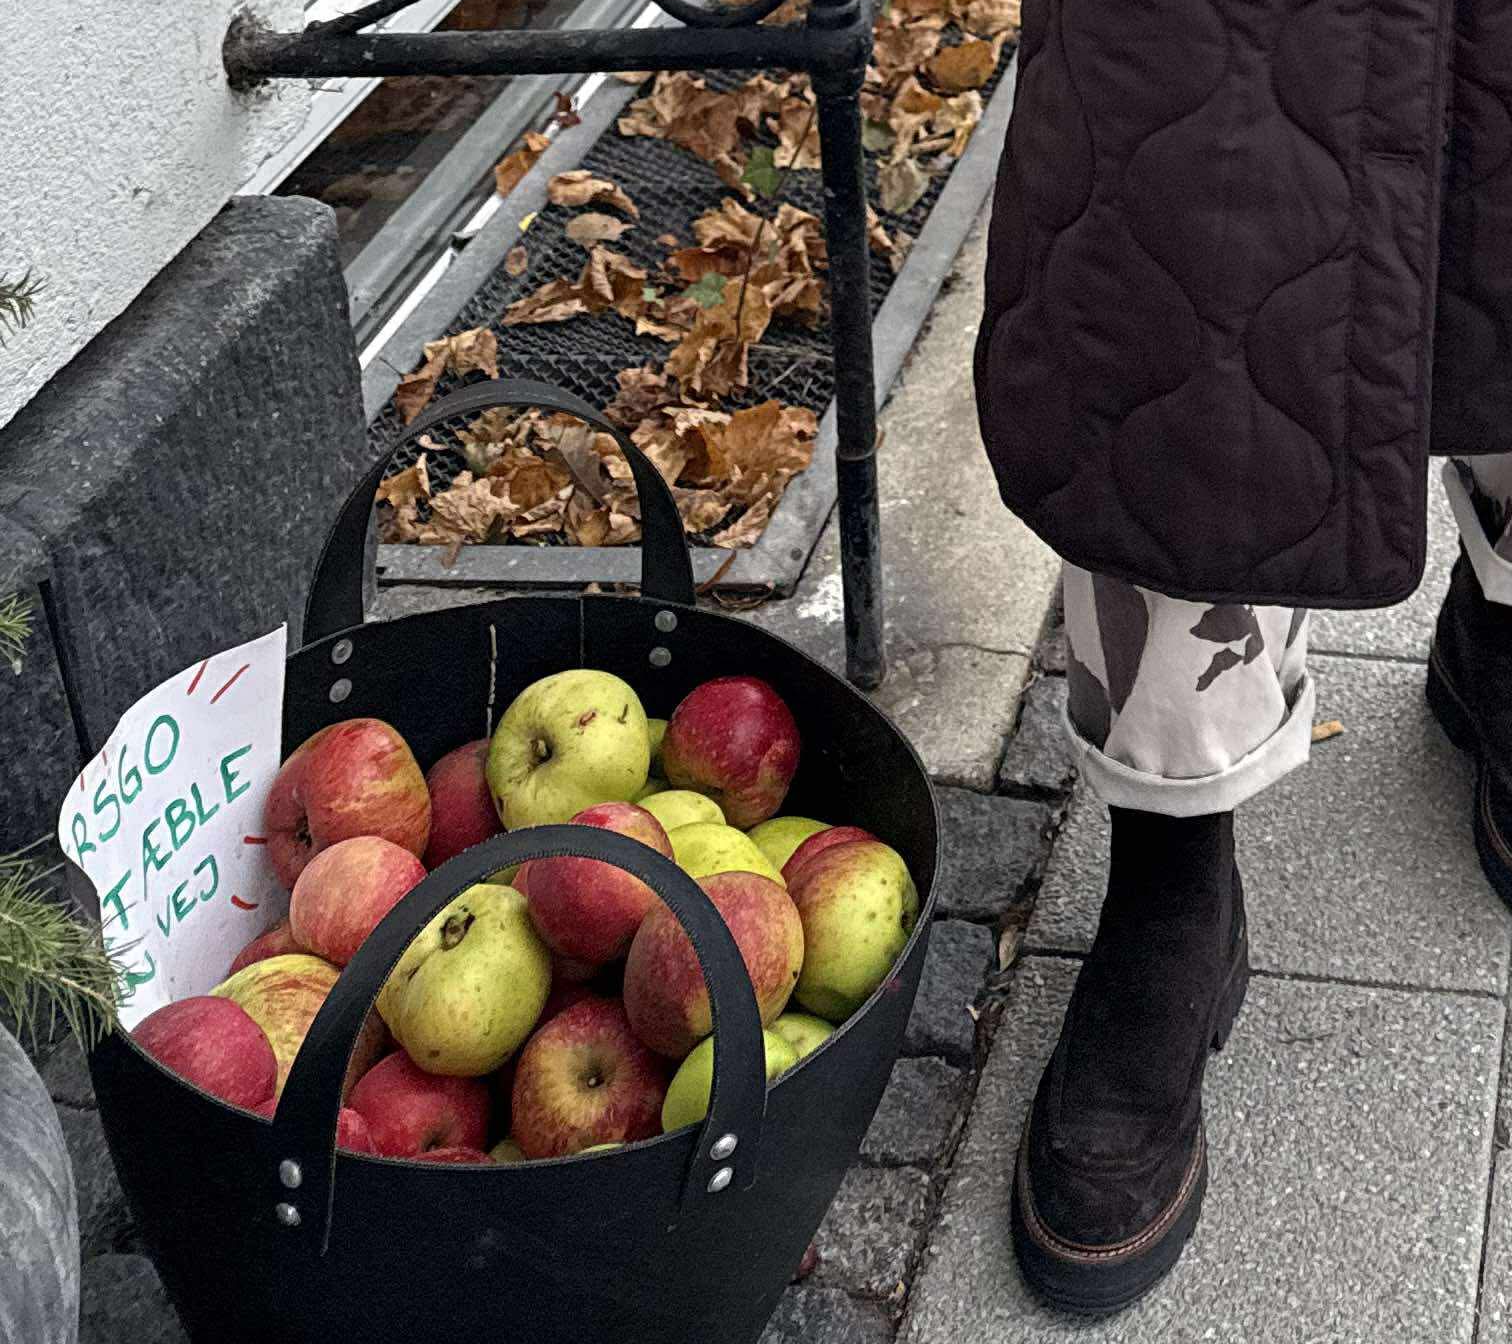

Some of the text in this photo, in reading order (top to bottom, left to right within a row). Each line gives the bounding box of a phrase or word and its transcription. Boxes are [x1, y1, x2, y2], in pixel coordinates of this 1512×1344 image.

[70, 714, 180, 869] RSGO
[142, 744, 252, 901] ÆBLE
[156, 854, 219, 938] VEJ
